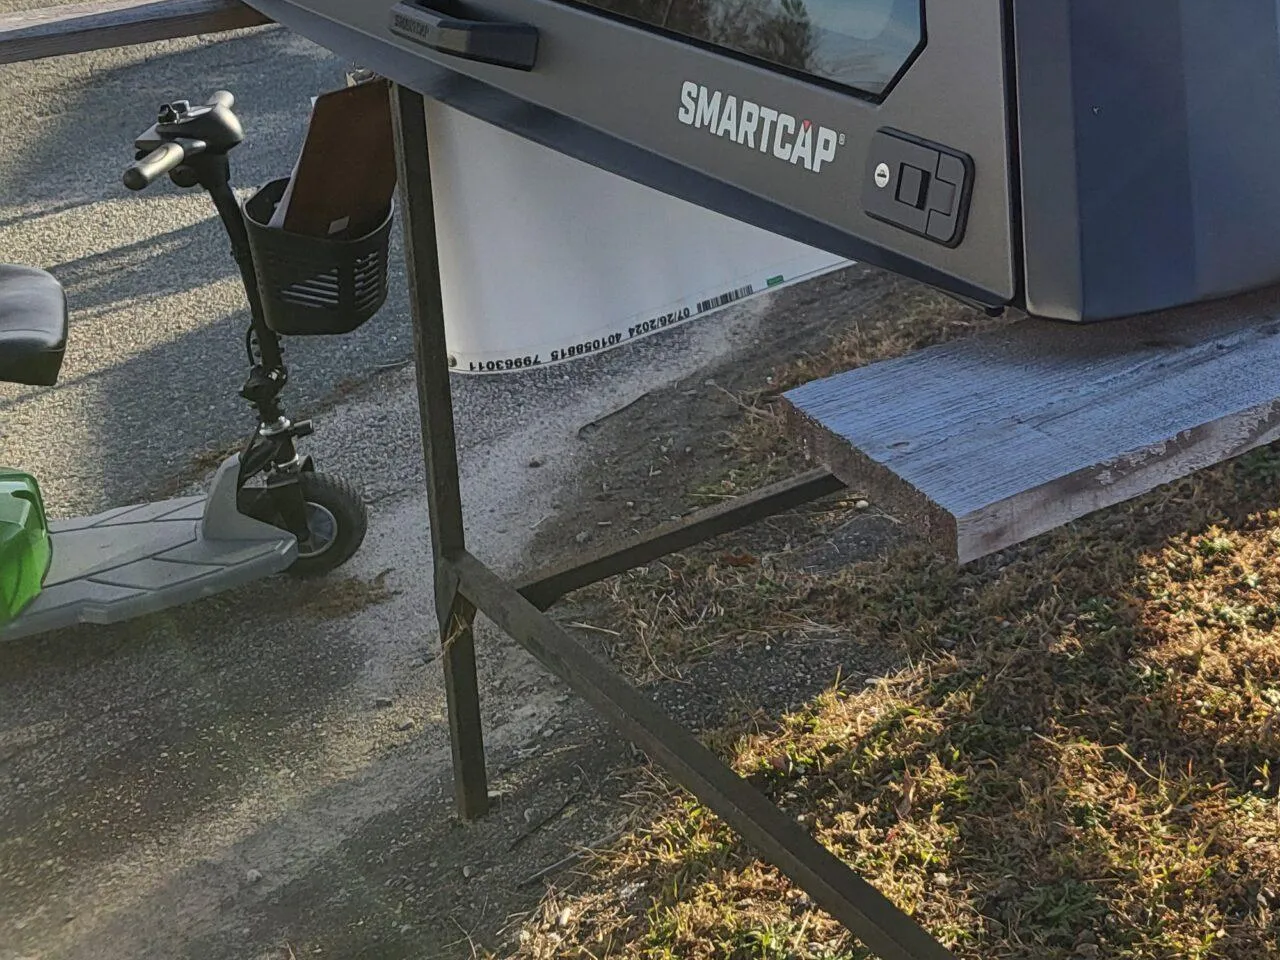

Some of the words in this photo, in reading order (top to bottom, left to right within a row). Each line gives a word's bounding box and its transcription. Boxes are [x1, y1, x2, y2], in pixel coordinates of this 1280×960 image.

[678, 80, 838, 173] SMARTCAP
[628, 306, 690, 338] 07/26/2024
[469, 353, 541, 372] 79963011
